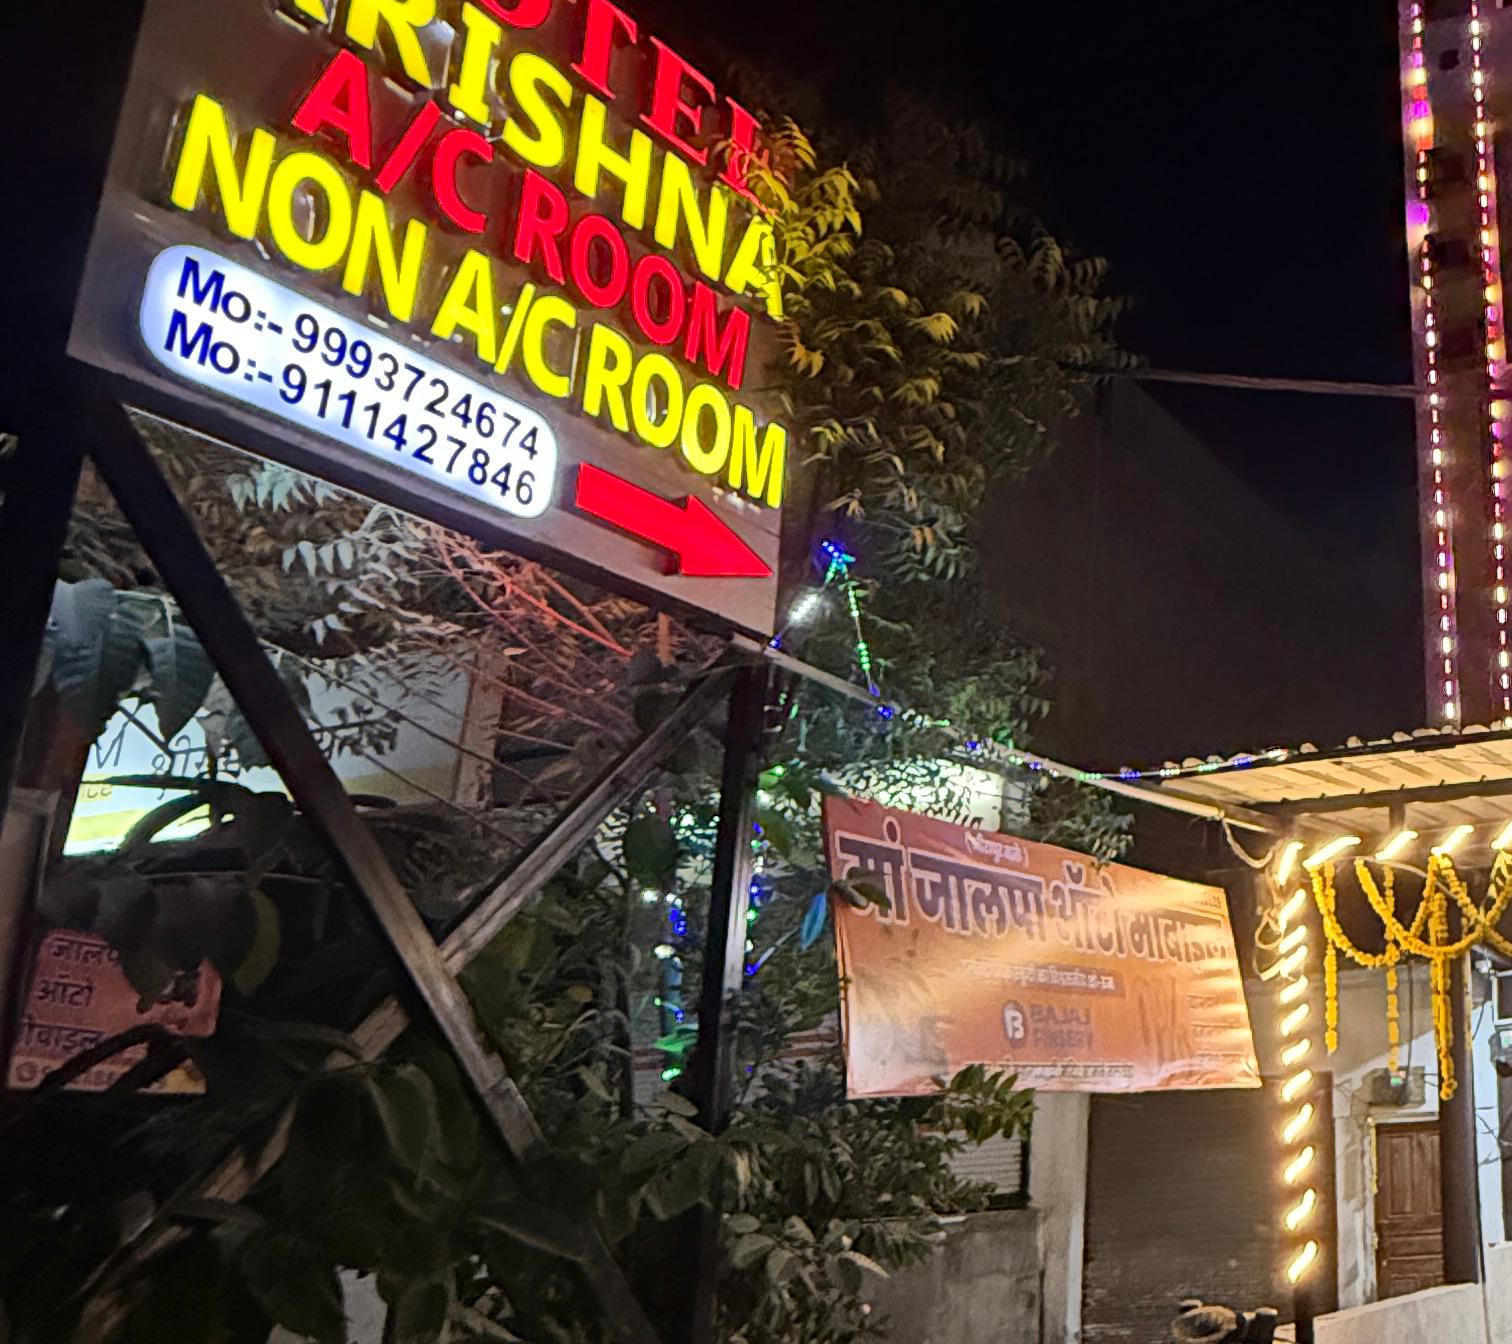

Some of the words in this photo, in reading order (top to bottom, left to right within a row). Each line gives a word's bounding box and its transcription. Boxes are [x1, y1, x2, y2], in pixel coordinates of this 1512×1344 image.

[171, 93, 427, 323] NON
[583, 326, 788, 509] ROOM
[291, 48, 495, 234] A/C
[513, 168, 751, 391] ROOM
